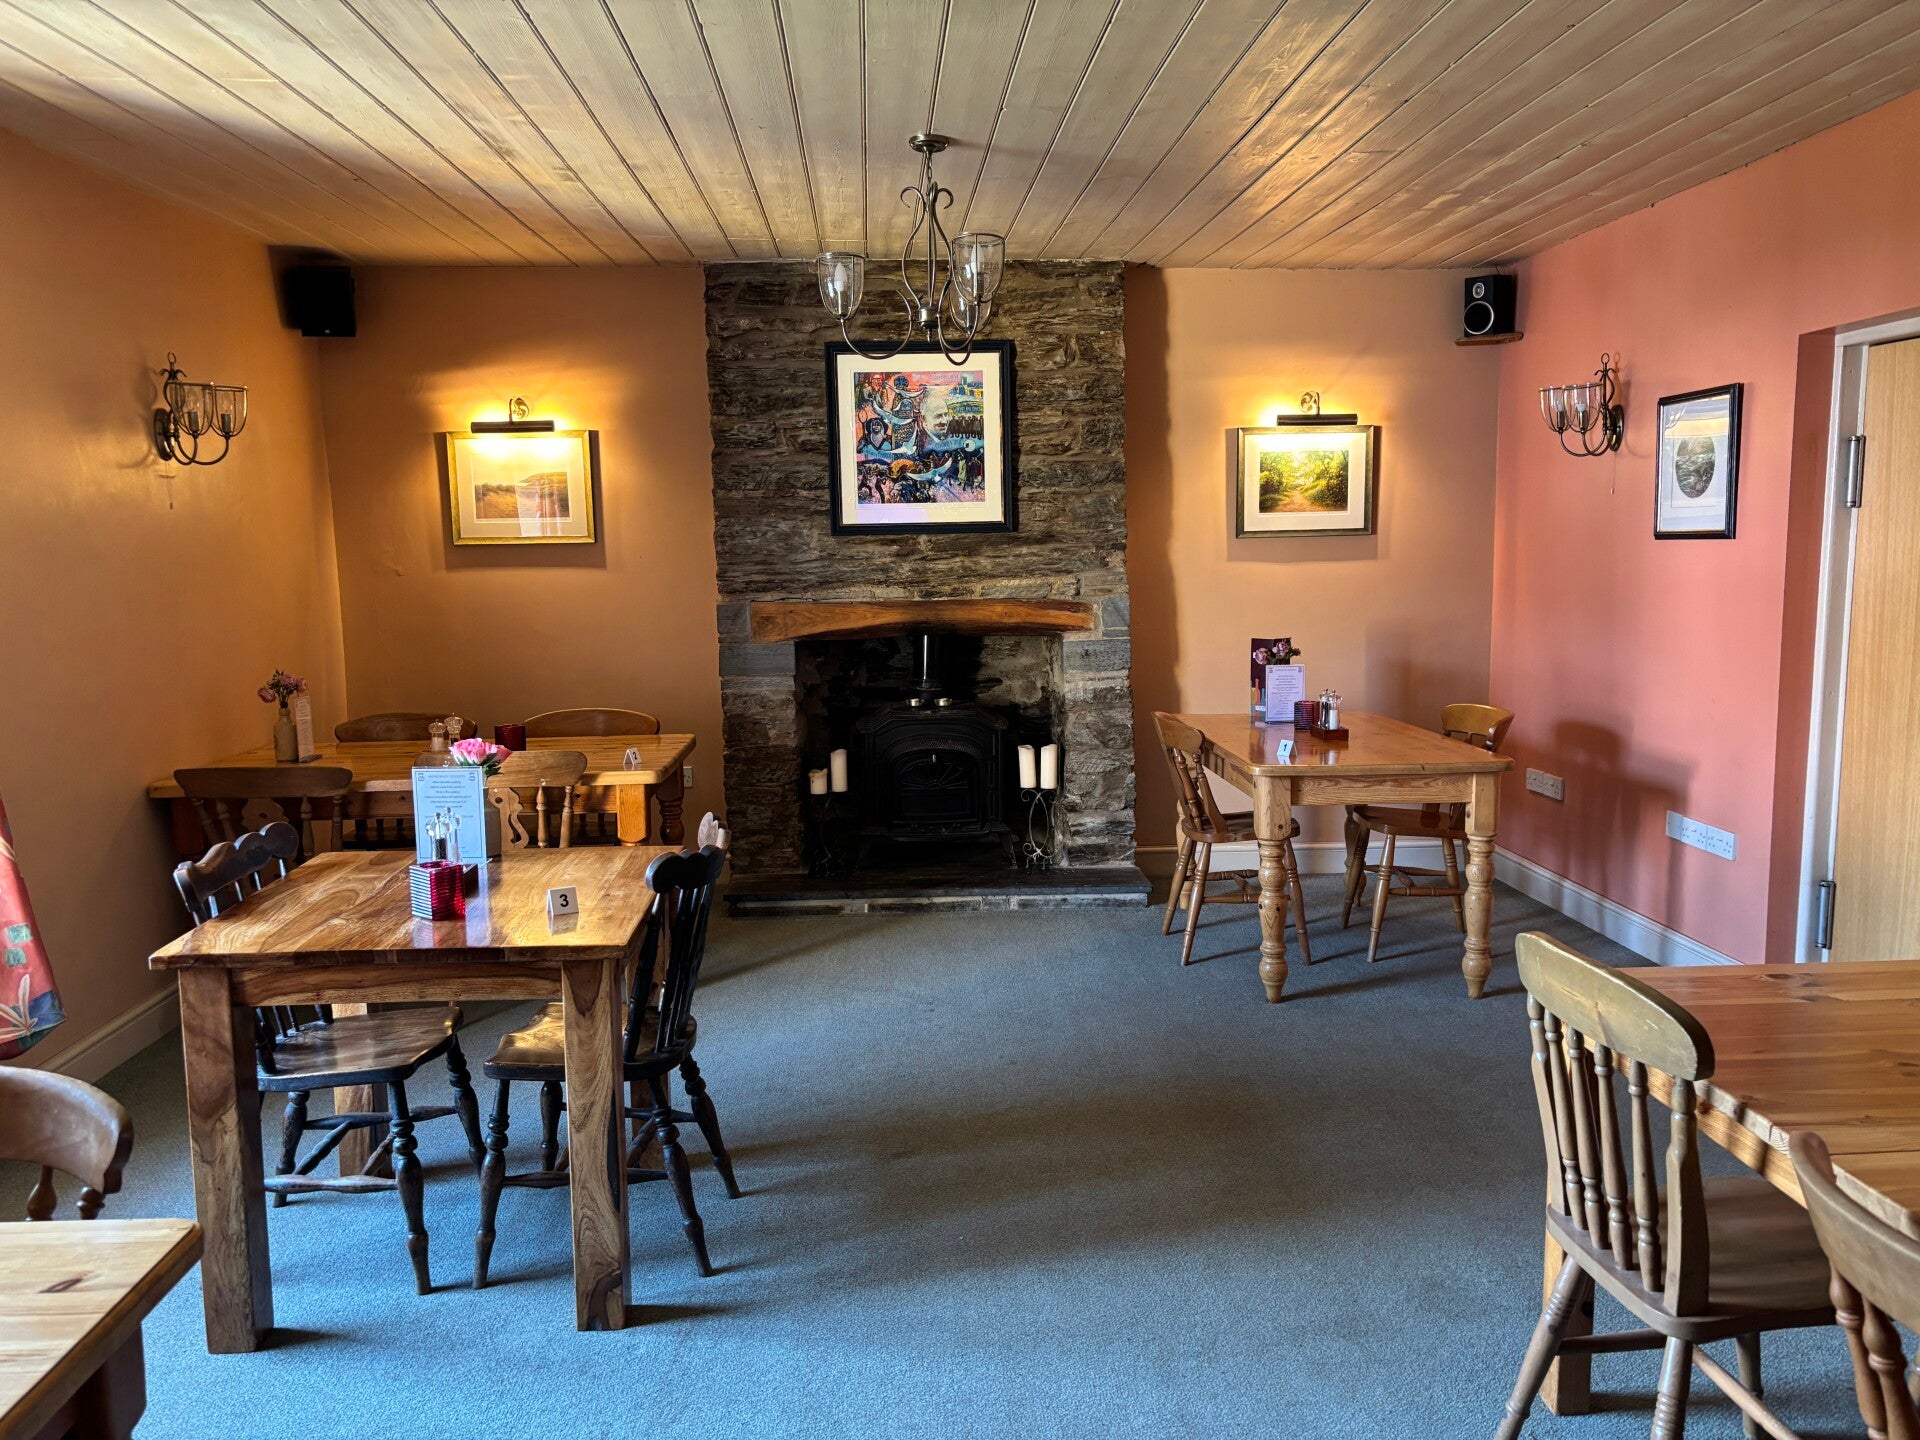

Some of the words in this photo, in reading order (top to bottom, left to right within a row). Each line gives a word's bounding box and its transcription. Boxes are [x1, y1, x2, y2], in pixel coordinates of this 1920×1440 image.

[1283, 743, 1288, 752] 1
[632, 751, 638, 760] 2
[559, 893, 569, 908] 3
